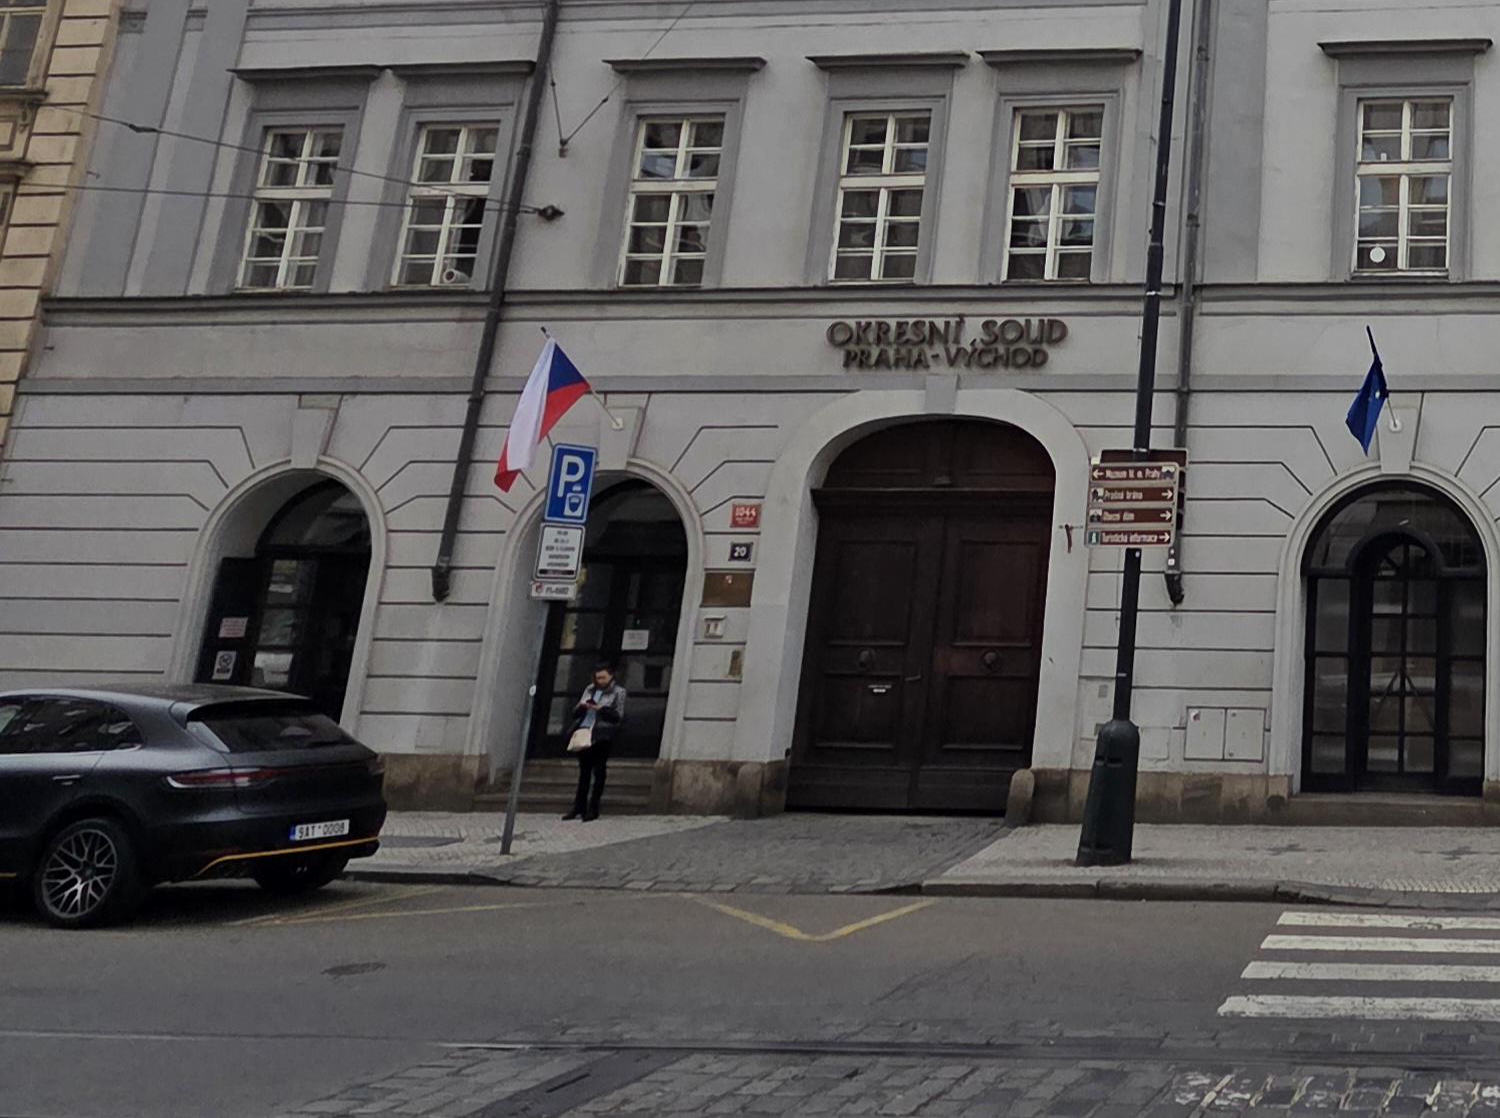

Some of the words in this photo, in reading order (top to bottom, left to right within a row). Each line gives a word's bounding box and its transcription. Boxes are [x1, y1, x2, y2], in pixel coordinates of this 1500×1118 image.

[827, 314, 965, 347] OKRESNÍ
[980, 319, 1068, 346] SOUD
[557, 455, 585, 498] P
[735, 507, 757, 517] 1044
[734, 546, 747, 557] 20
